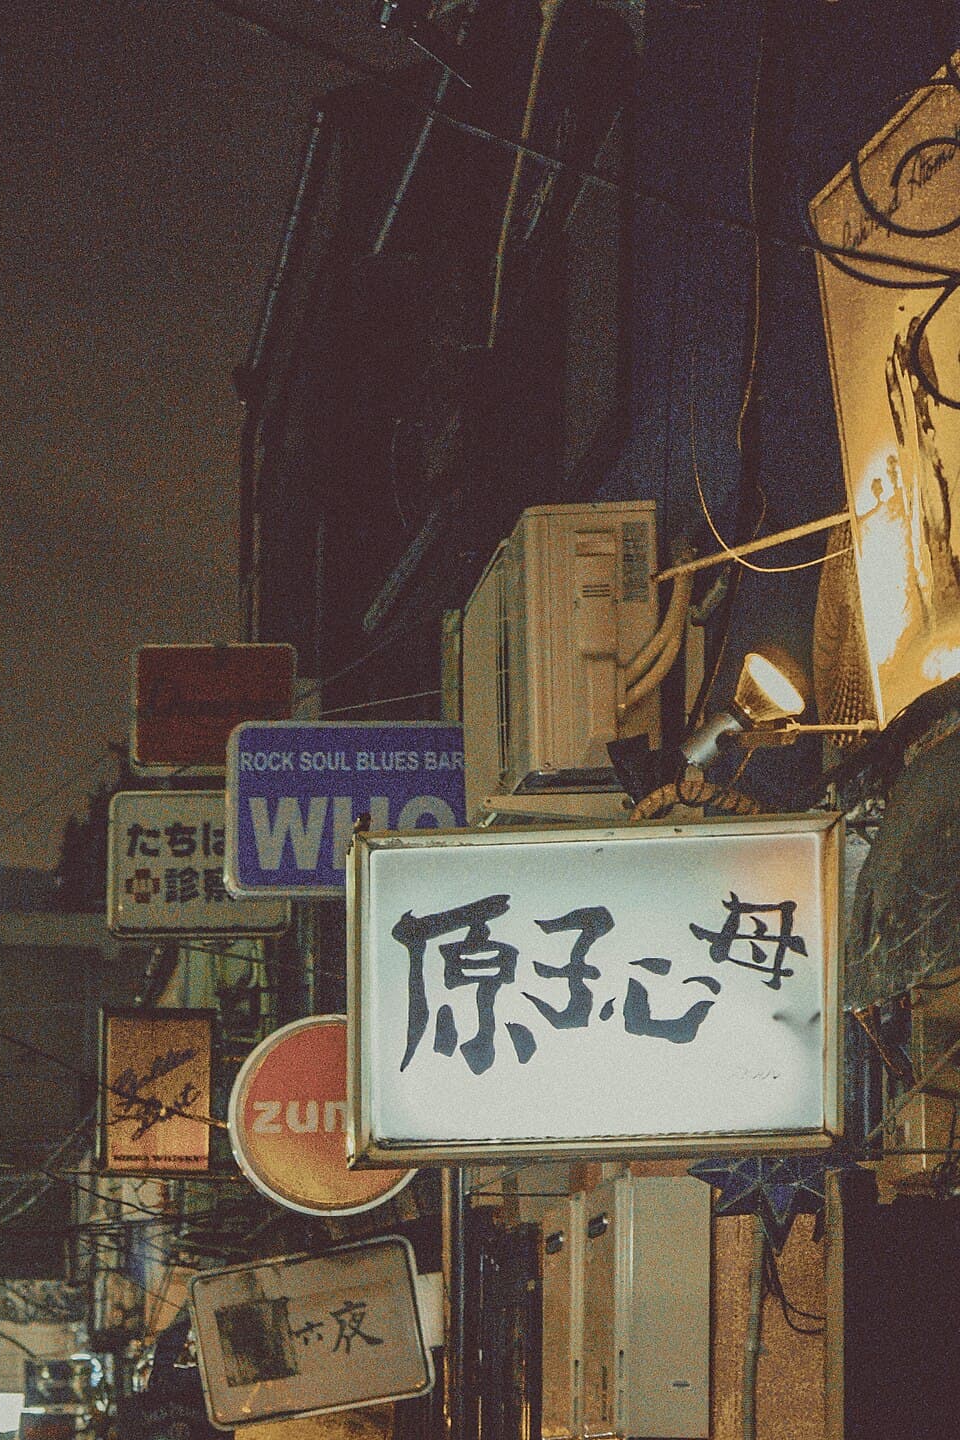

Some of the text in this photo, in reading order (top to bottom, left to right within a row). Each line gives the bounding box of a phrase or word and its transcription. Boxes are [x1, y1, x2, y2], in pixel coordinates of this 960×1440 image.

[240, 751, 464, 771] ROCK SOUL BLUES BAR
[391, 890, 809, 1075] 原子心母
